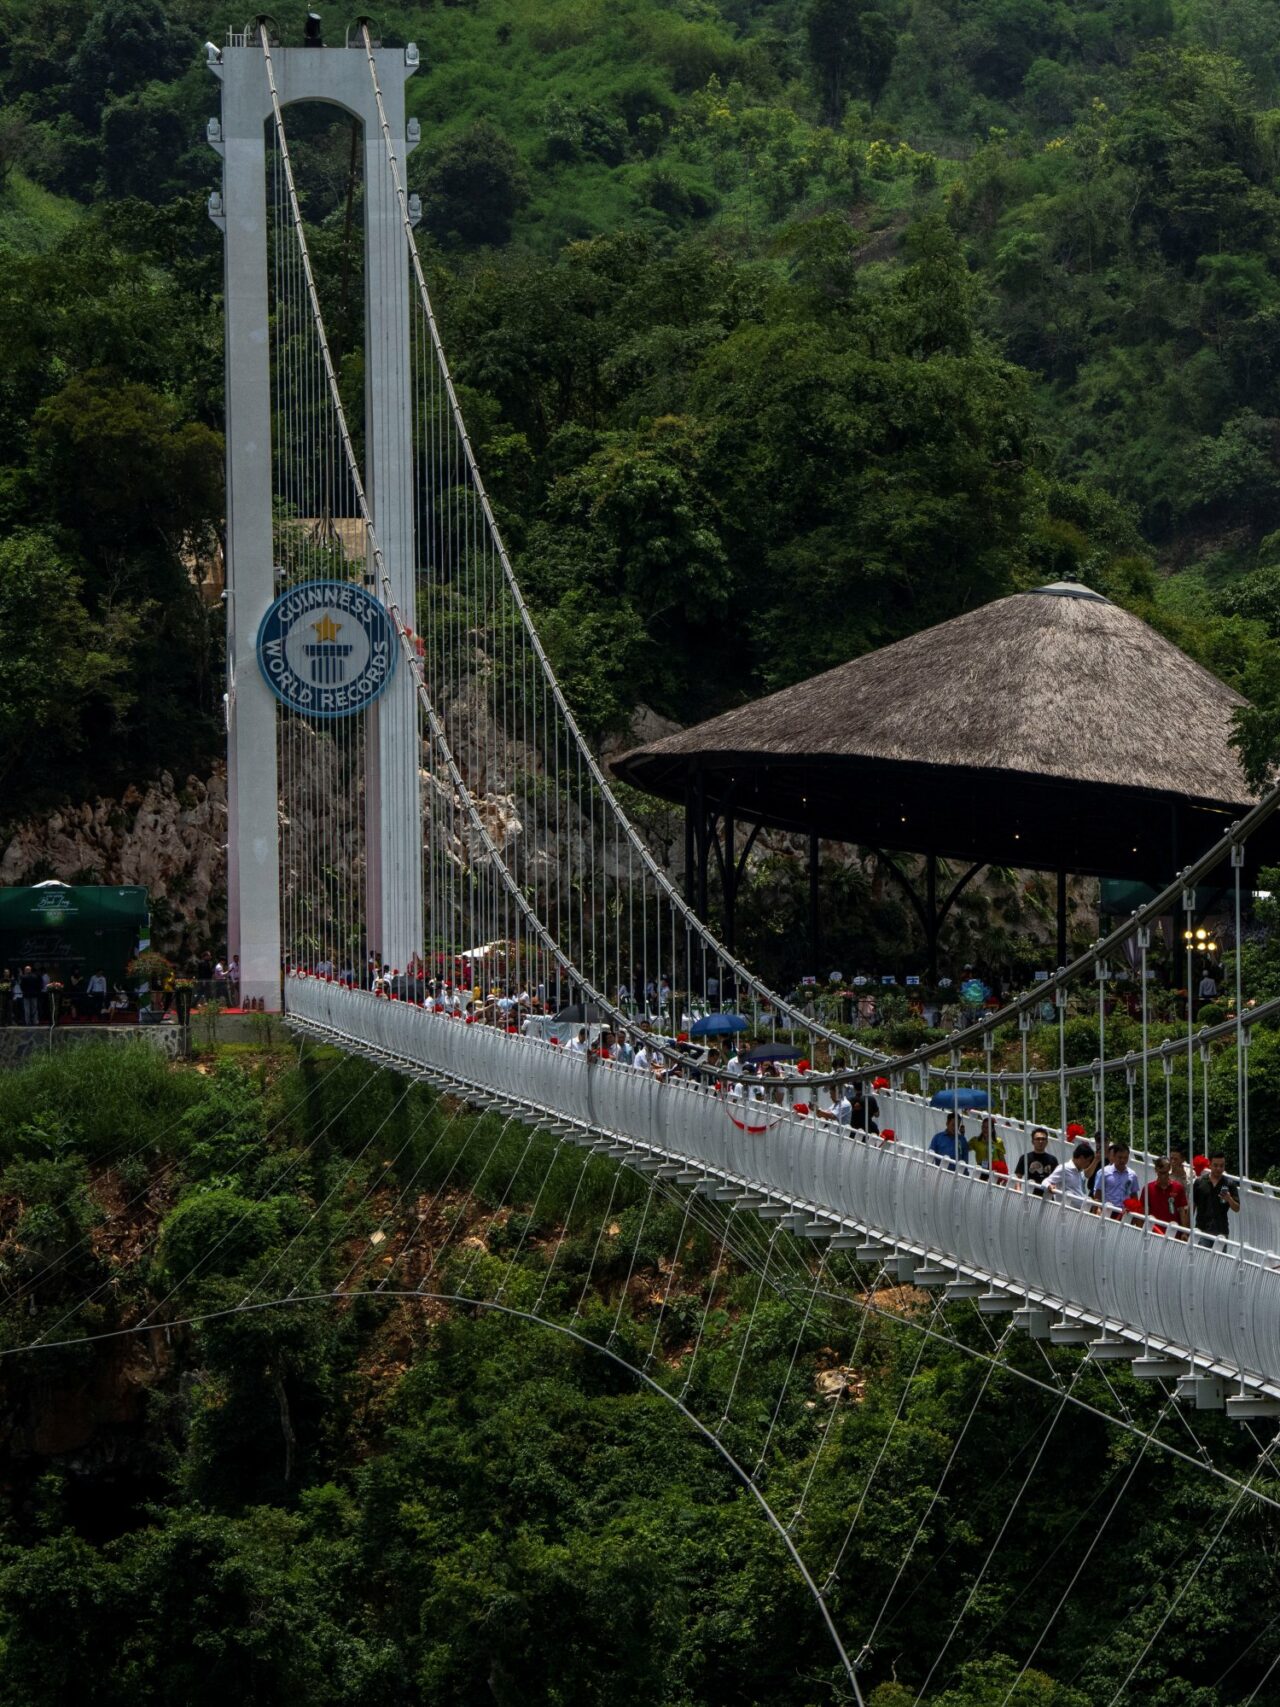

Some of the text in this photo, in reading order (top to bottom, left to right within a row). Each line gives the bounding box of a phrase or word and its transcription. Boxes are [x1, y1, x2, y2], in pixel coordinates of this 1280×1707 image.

[277, 587, 378, 622] GUINNESS
[266, 638, 389, 708] WORLD RECORDS
